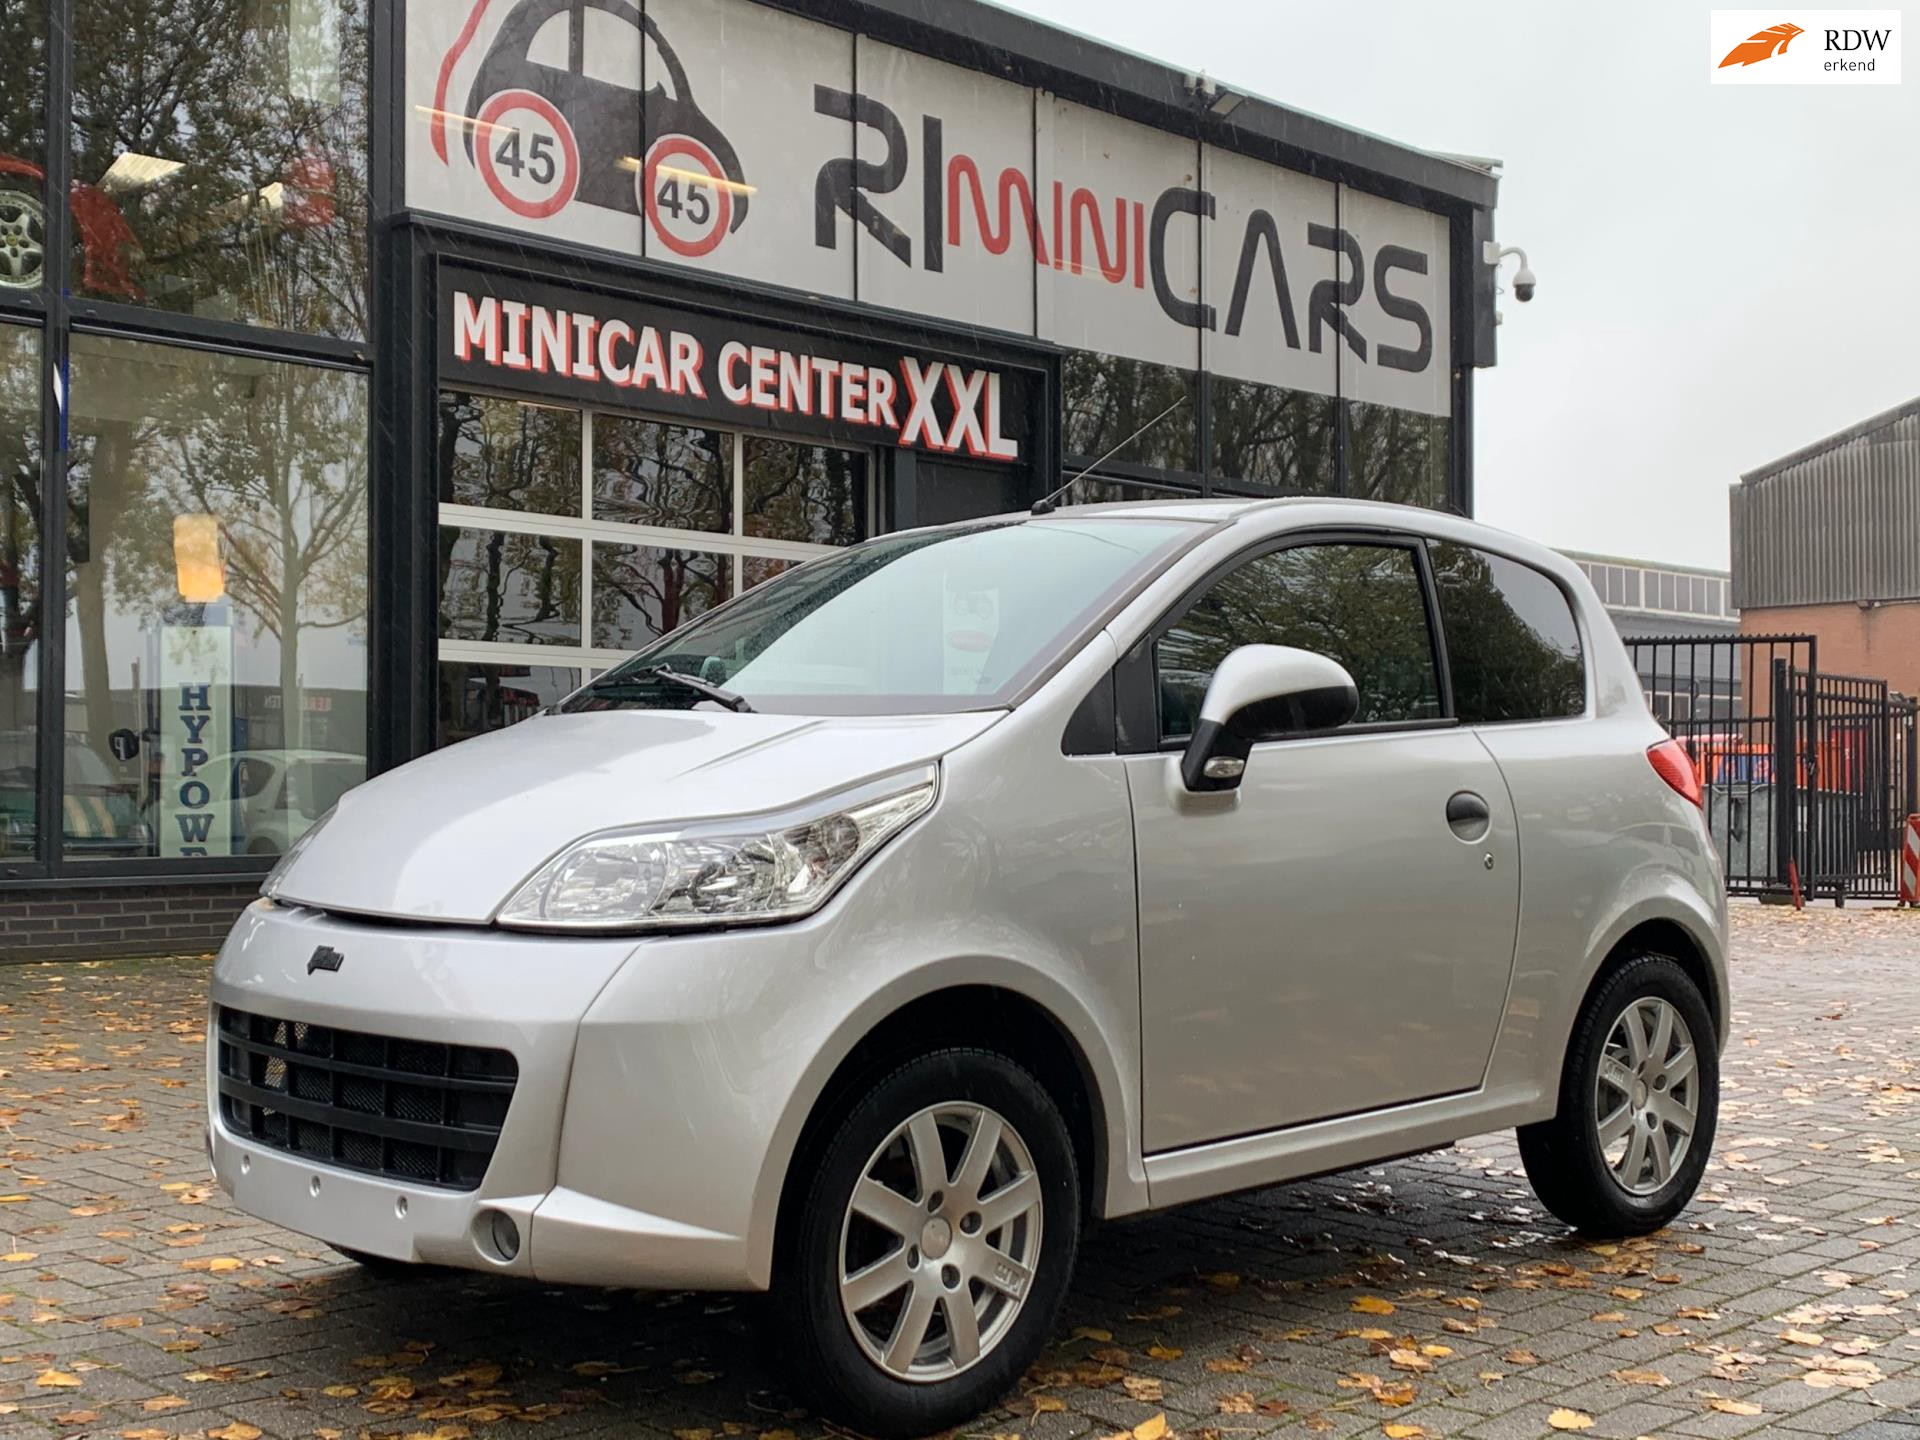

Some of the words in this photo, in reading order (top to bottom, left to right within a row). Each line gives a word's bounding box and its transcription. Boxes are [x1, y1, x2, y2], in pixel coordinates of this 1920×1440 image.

[494, 126, 556, 185] 45
[657, 177, 711, 226] 45
[453, 290, 707, 399] MINICAR
[717, 341, 898, 429] CENTER
[898, 356, 1018, 462] XXL
[174, 682, 215, 856] HYPOW
